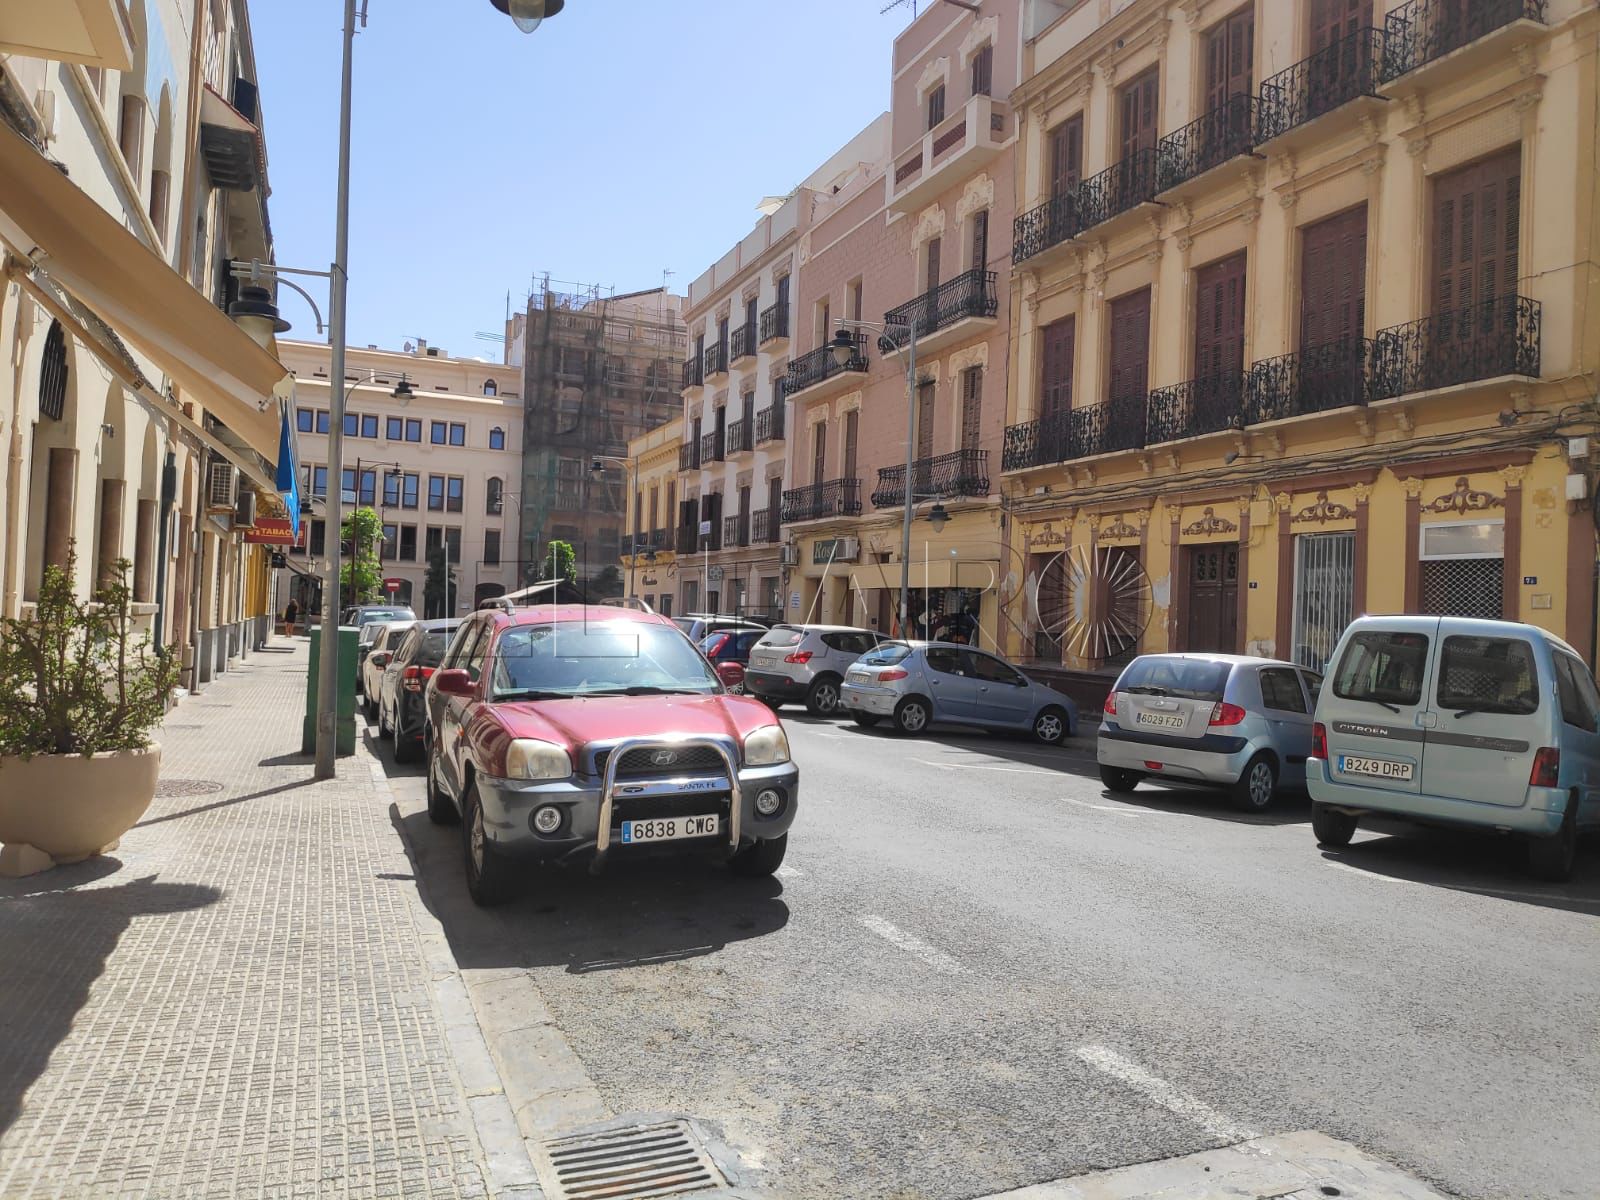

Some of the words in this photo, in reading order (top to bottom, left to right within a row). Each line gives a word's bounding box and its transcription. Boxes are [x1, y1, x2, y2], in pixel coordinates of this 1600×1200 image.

[1141, 714, 1164, 725] 6029
[1165, 716, 1183, 727] FZD
[1346, 758, 1379, 773] 8249
[1383, 762, 1409, 777] DRP
[634, 821, 675, 839] 6838
[686, 817, 714, 835] CWG
